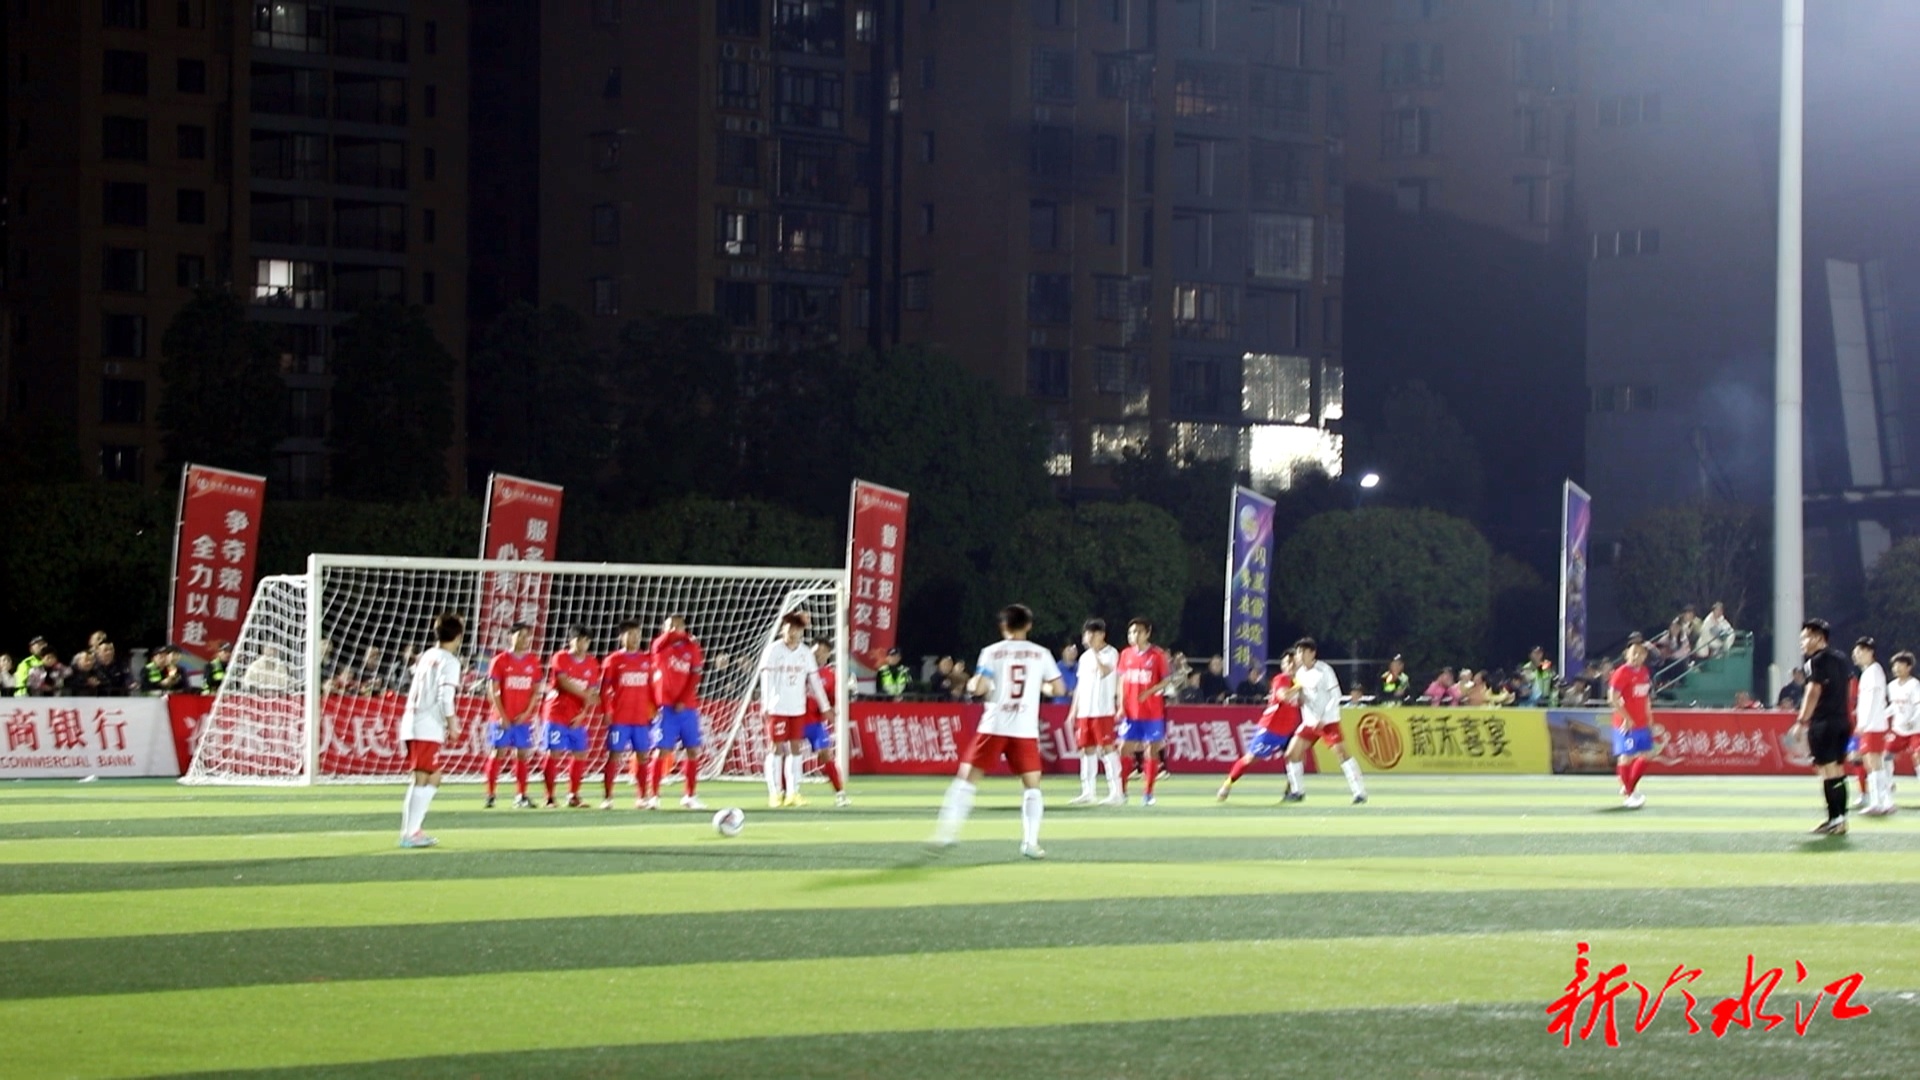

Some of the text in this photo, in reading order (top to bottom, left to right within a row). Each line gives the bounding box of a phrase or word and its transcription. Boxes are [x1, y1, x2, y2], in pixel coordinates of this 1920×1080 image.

[181, 534, 217, 646] 全力以赴
[214, 509, 249, 620] 争夺荣耀
[853, 547, 877, 655] 冷江农商
[1011, 665, 1026, 699] 5
[0, 708, 128, 751] 商银行
[0, 755, 136, 768] COMMERCIAL BANK
